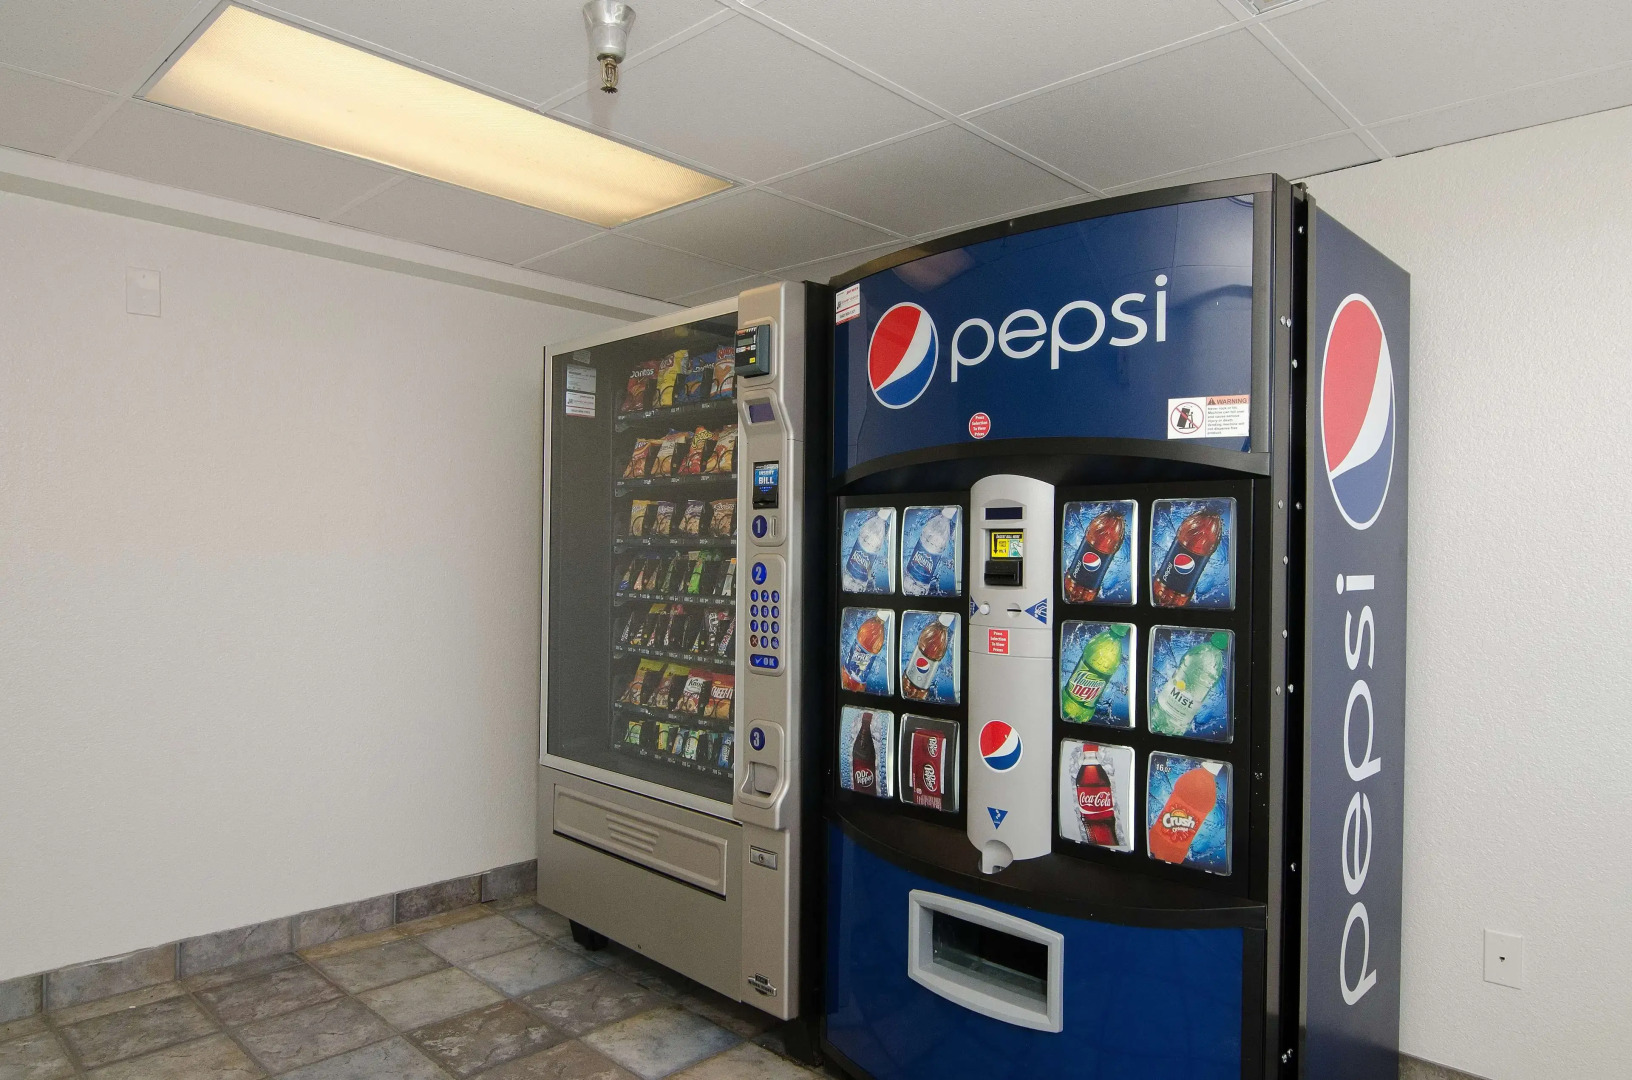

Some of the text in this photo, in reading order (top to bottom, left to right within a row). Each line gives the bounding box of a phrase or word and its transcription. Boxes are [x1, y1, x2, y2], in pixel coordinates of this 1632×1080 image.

[951, 274, 1168, 383] pepsi
[630, 368, 655, 379] Doritos
[758, 476, 774, 485] BILL
[755, 519, 761, 534] 1
[755, 566, 762, 581] 2
[1073, 560, 1082, 578] pepsi
[1163, 562, 1173, 581] pepsi
[763, 657, 774, 666] OK
[1170, 687, 1195, 709] Mist
[753, 732, 760, 746] 3
[1156, 763, 1164, 771] 16
[1336, 573, 1381, 1005] pepsi
[1080, 791, 1111, 807] Coca-Cola
[1163, 812, 1195, 829] Crush
